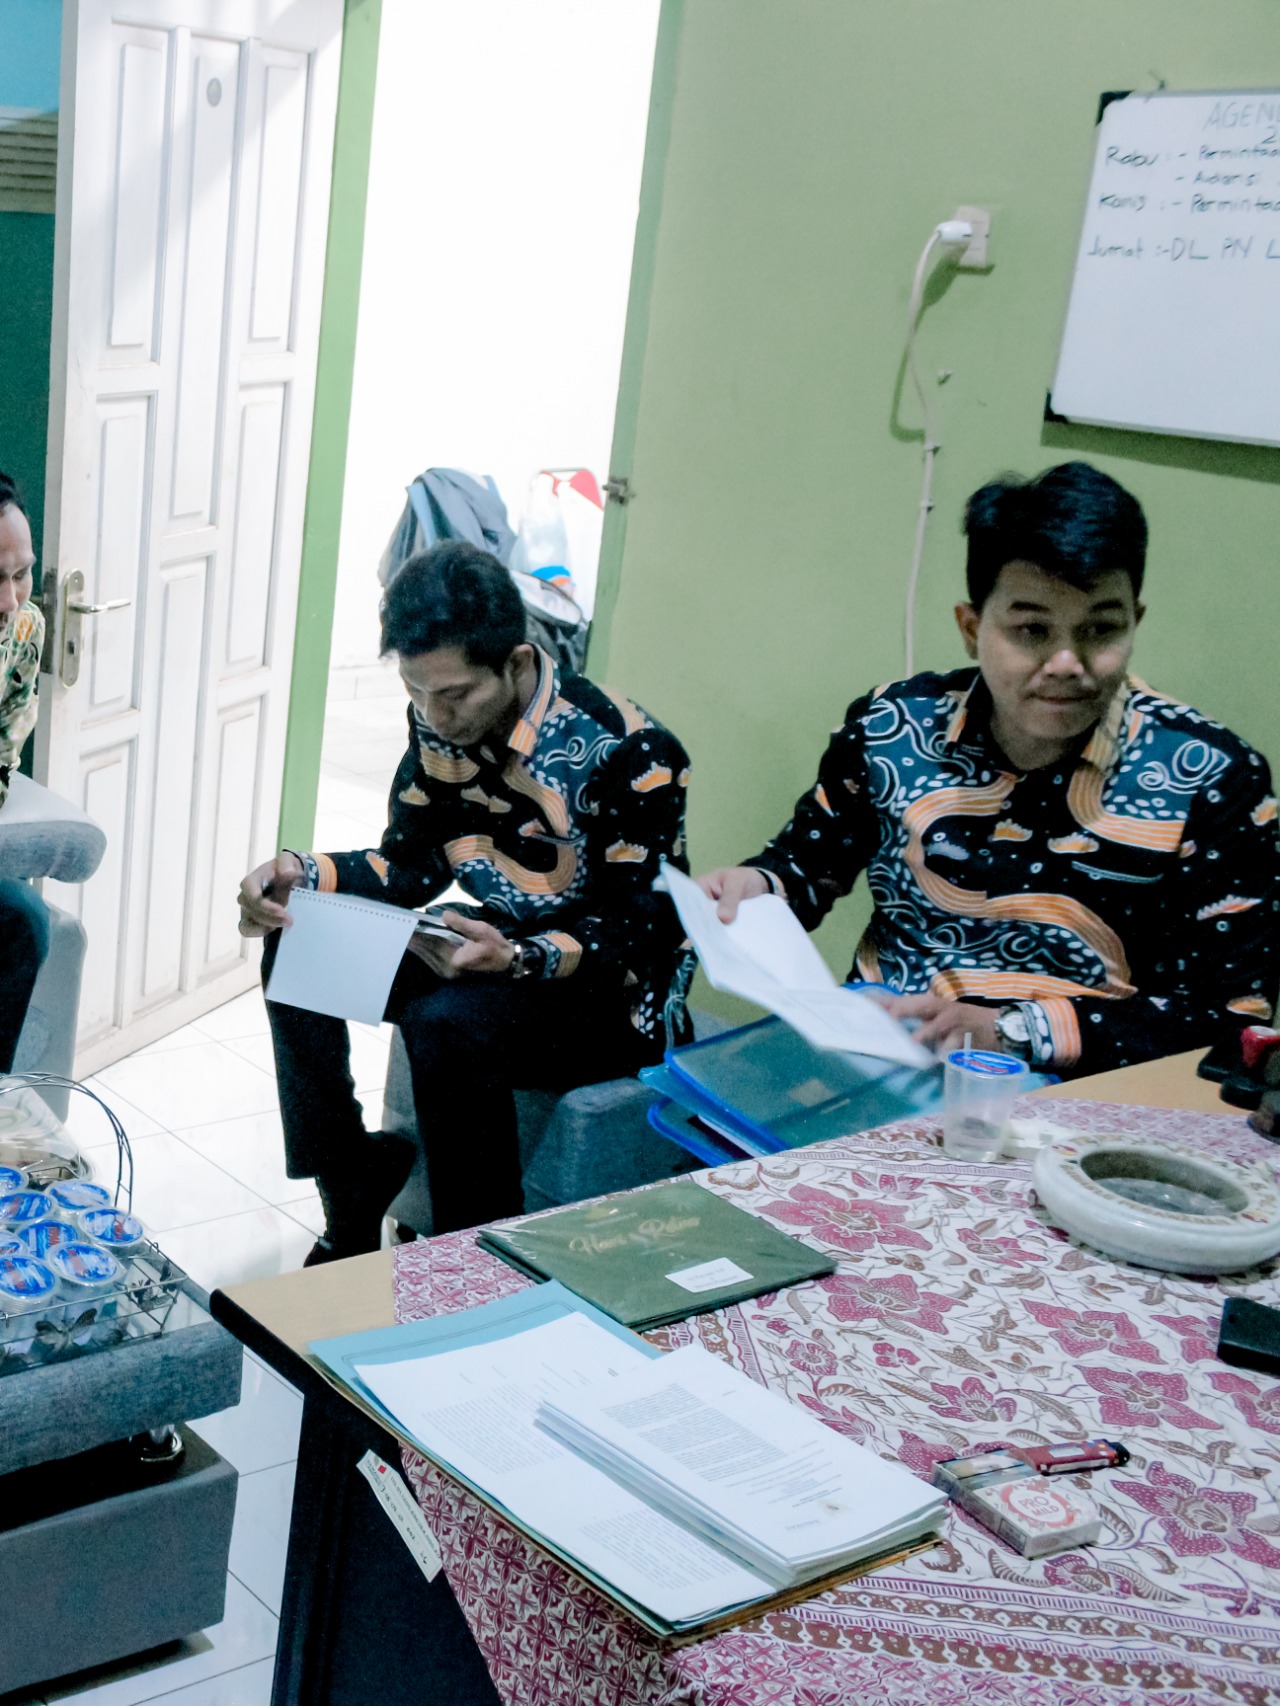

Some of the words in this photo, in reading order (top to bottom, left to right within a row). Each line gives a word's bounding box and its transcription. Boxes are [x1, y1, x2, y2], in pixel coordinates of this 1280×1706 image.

[1202, 101, 1280, 131] AGEN
[1018, 1496, 1050, 1511] PRO
[1031, 1505, 1060, 1516] MILD
